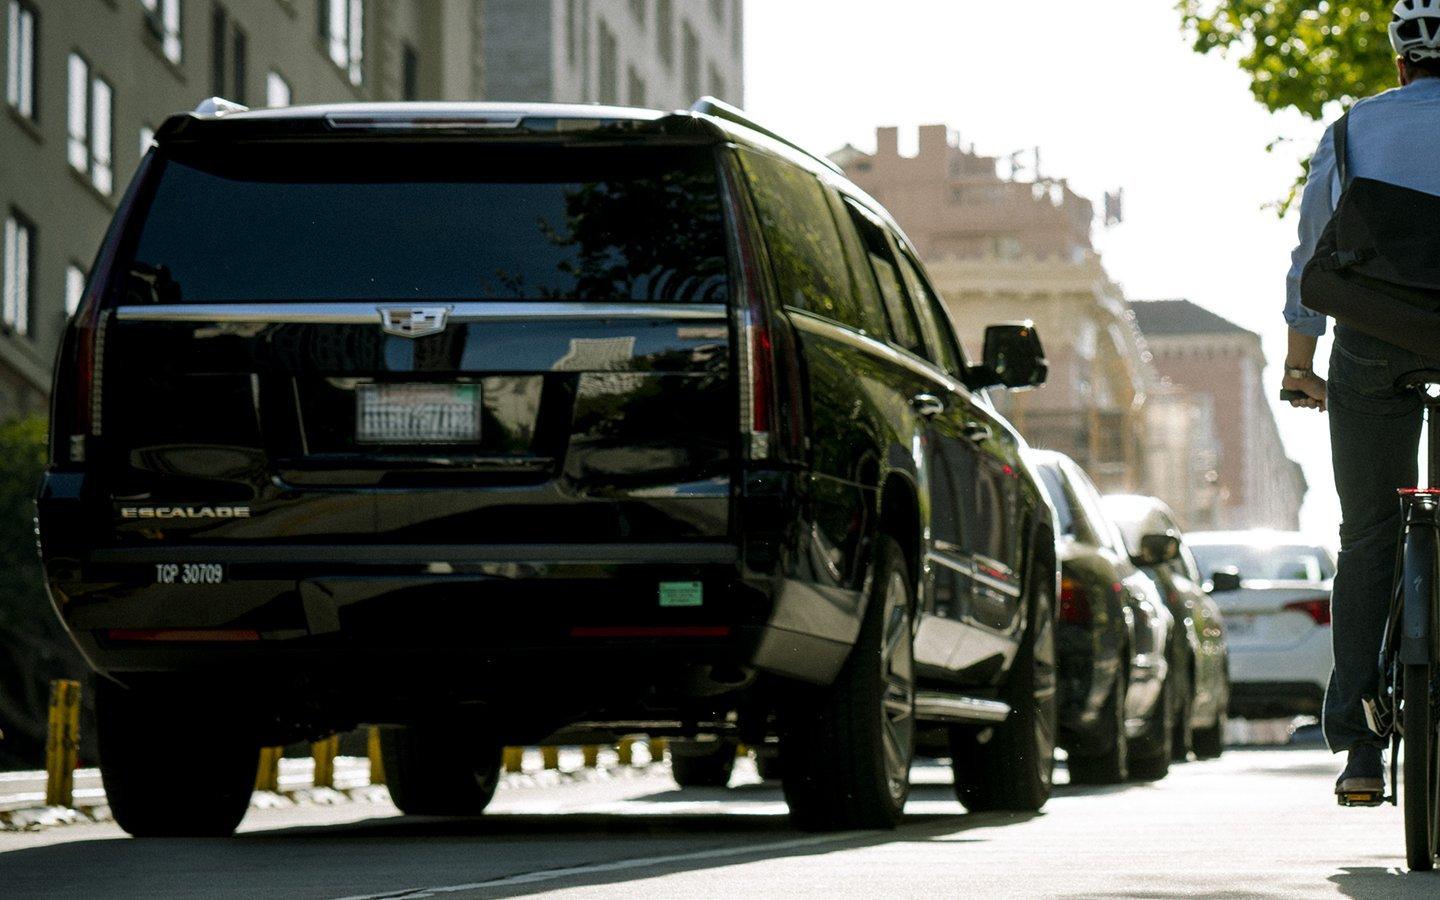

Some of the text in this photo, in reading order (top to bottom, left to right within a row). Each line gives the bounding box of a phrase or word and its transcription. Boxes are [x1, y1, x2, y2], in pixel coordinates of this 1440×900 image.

[121, 506, 250, 519] ESCALADE
[155, 563, 223, 584] TCP 30709
